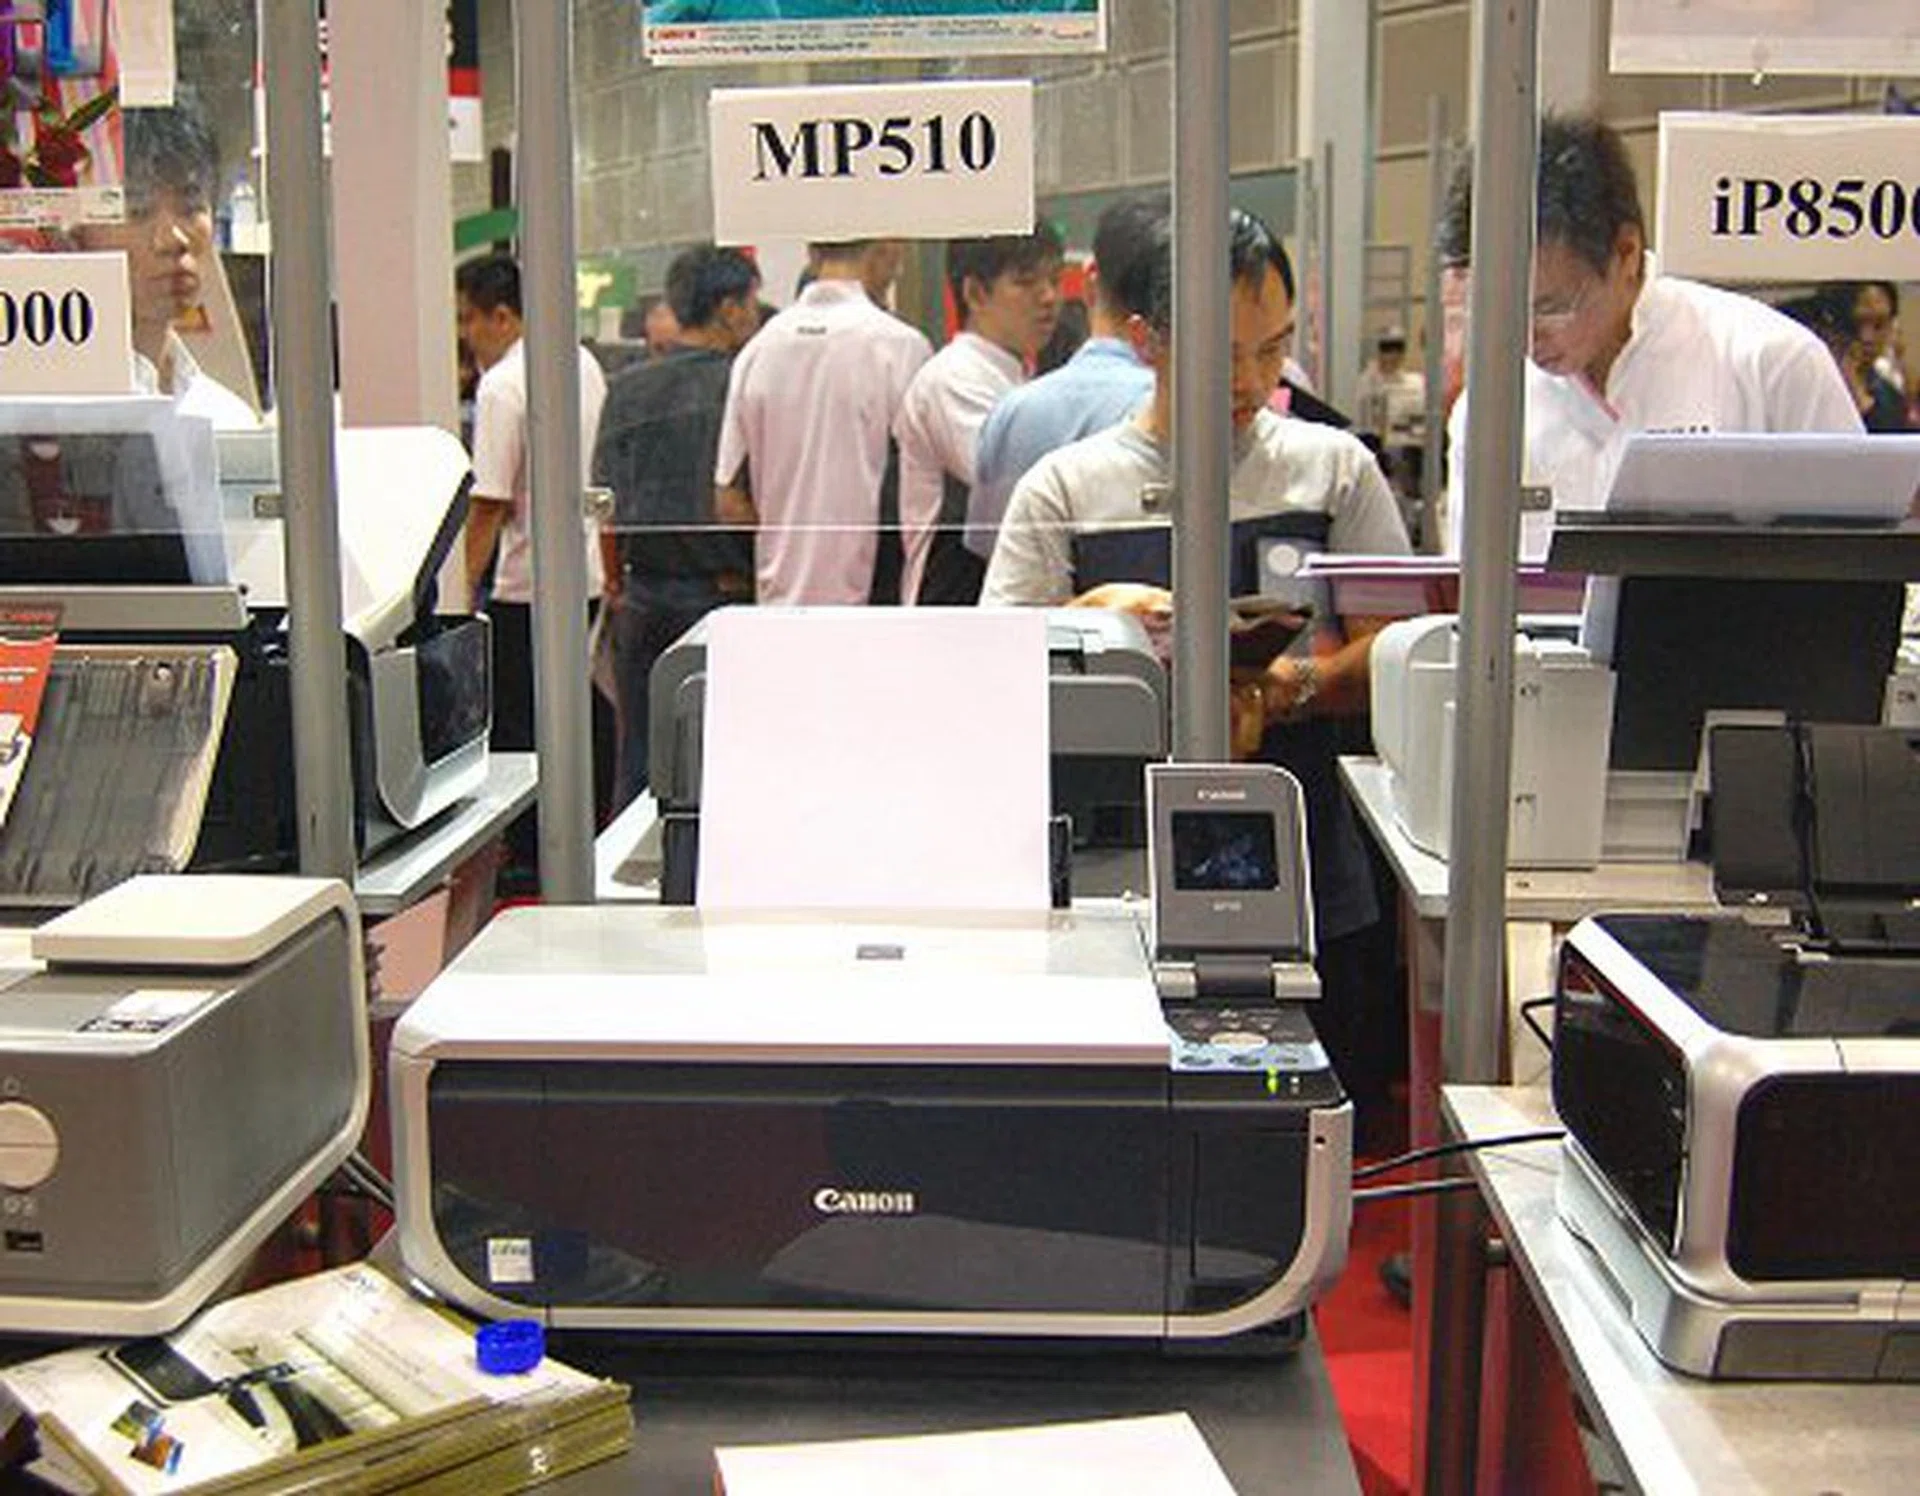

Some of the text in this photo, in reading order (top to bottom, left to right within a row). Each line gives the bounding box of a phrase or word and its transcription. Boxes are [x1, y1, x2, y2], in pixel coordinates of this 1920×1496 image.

[751, 111, 996, 181] MP510
[1712, 178, 1920, 239] iP850
[814, 1188, 914, 1213] Canon
